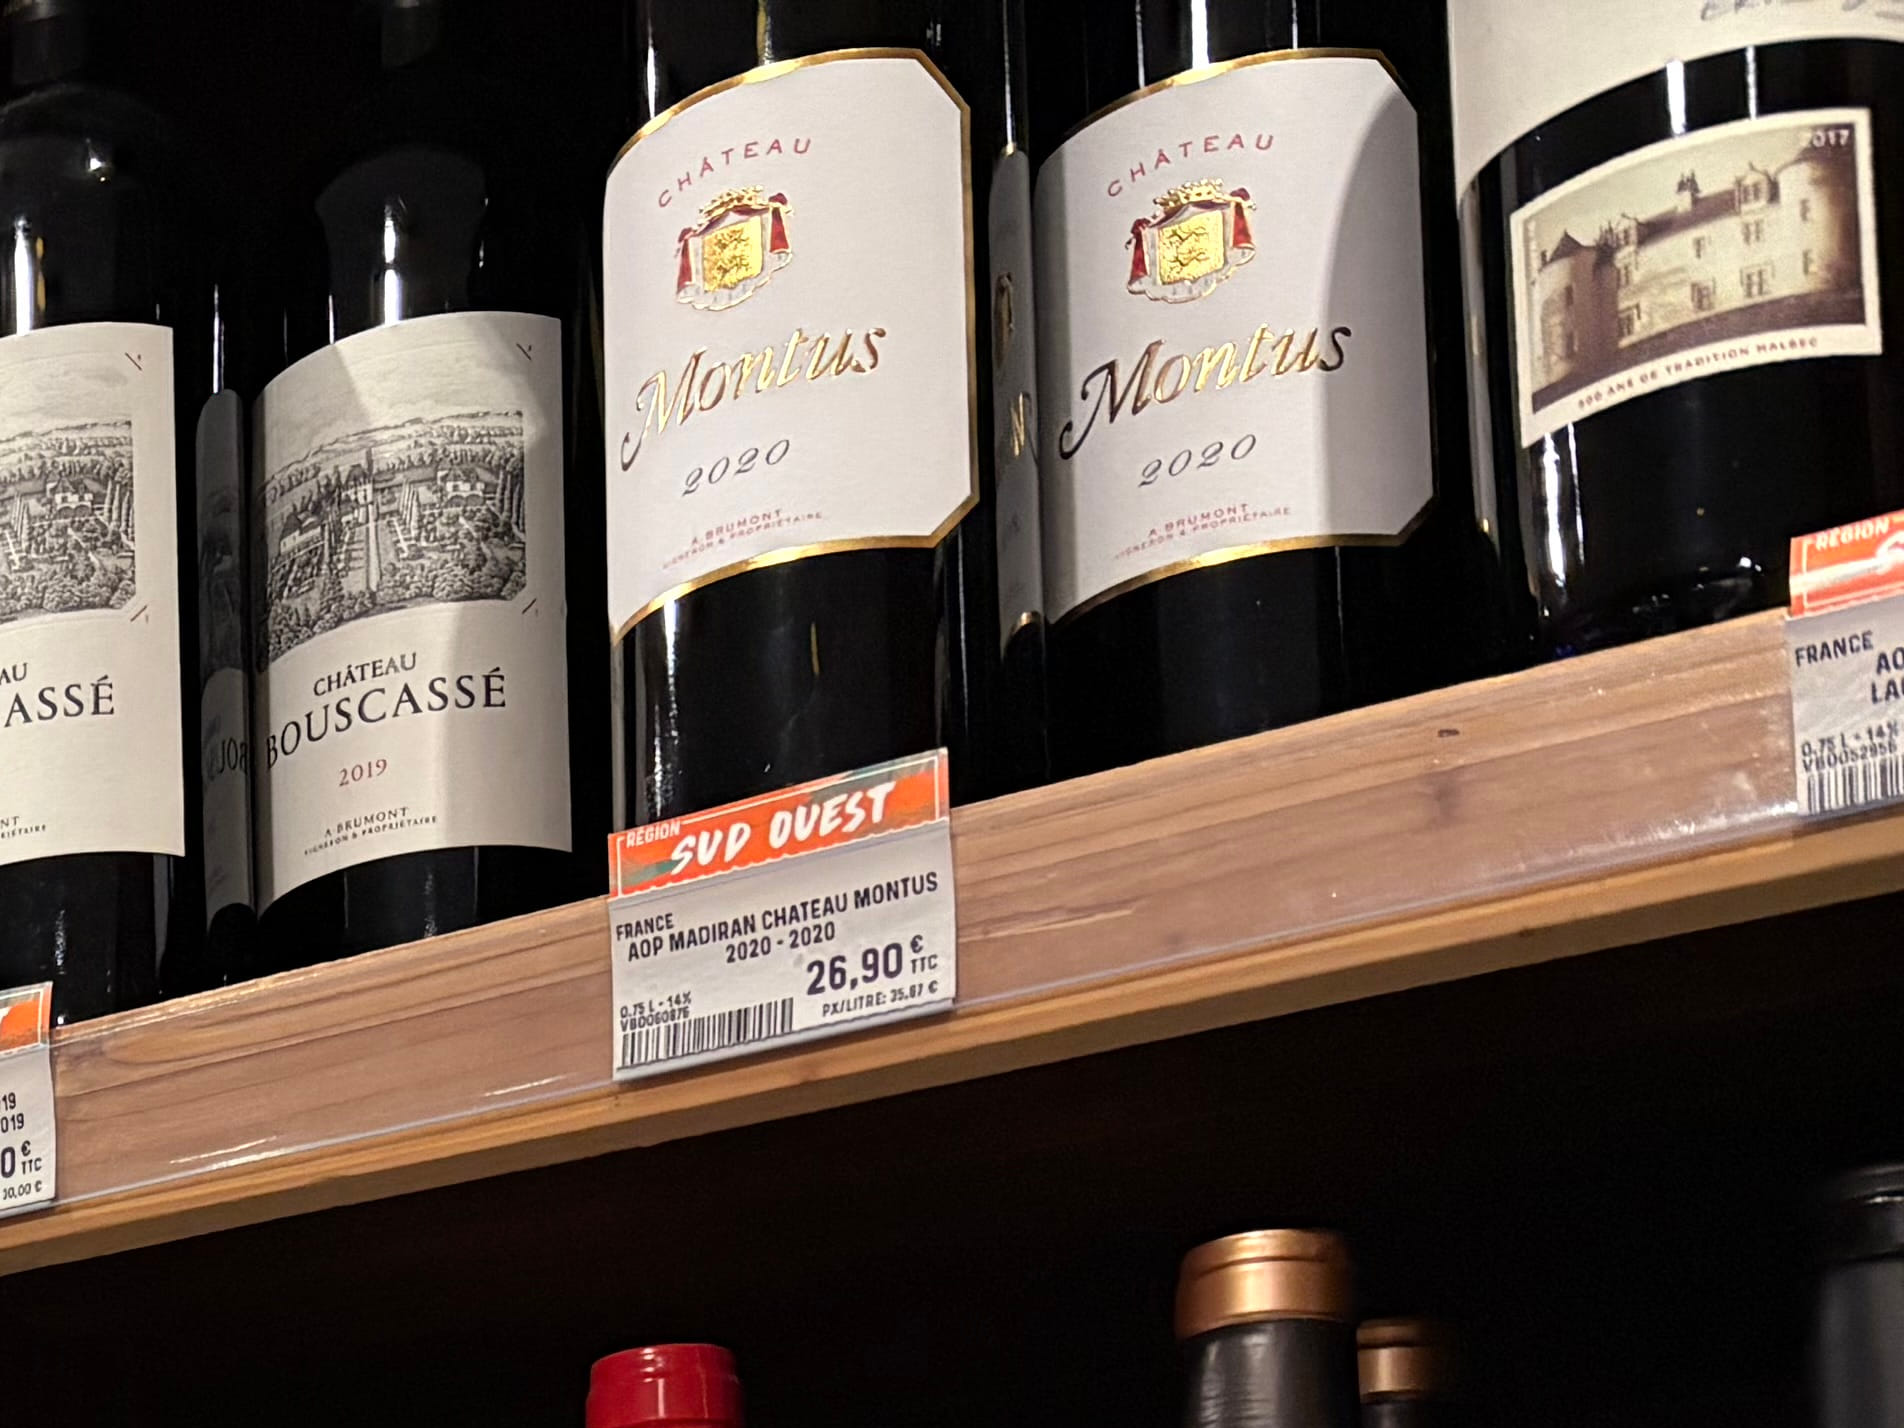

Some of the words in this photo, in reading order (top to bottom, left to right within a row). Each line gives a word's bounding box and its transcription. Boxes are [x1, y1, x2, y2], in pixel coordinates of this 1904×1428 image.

[658, 138, 811, 208] CHÂTEAU
[1107, 134, 1274, 198] CHÂTEAU
[1756, 336, 1819, 354] MALBEC
[621, 327, 886, 472] Montus
[1059, 323, 1351, 459] Montus
[682, 439, 790, 496] 2020
[1137, 435, 1256, 488] 2020
[314, 652, 417, 697] CHÂTEAU
[1796, 631, 1873, 667] FRANCE
[266, 668, 505, 769] BOUSCASSÉ
[339, 760, 387, 787] 2019
[671, 822, 751, 875] SUD
[769, 782, 896, 849] OUEST
[616, 913, 674, 941] FRANCE
[628, 936, 664, 961] AOP
[669, 914, 756, 952] MADIRAN
[762, 892, 848, 931] CHATEAU
[854, 872, 938, 909] MONTUS
[726, 938, 771, 964] 2020
[790, 921, 835, 949] 2020
[806, 942, 903, 996] 26,90
